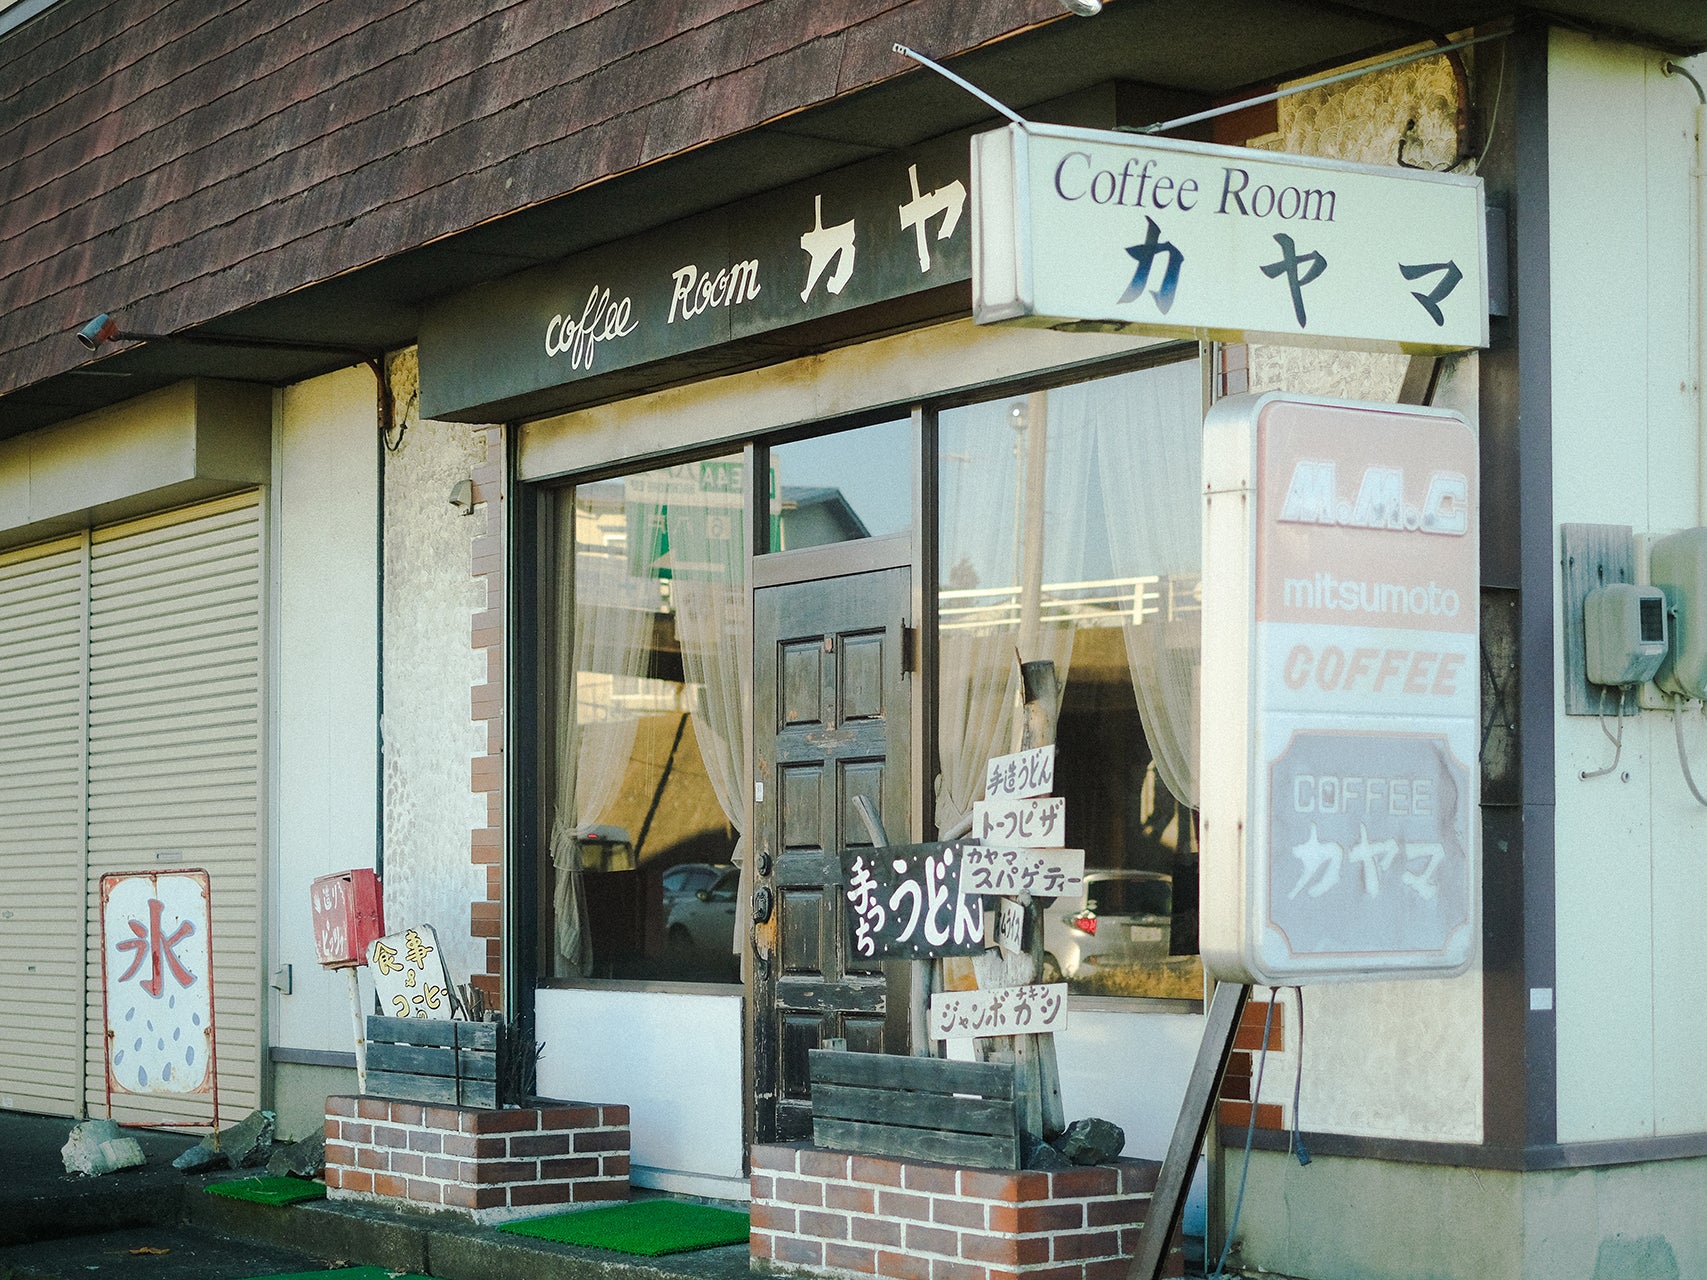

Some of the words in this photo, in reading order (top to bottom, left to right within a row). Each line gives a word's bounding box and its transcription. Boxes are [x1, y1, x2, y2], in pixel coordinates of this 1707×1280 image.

[1054, 151, 1199, 212] Coffee
[1214, 167, 1337, 222] Room
[1117, 215, 1463, 329] カヤマ
[545, 284, 639, 370] coffee
[667, 259, 761, 324] Room
[1283, 571, 1460, 618] mitsumoto
[1283, 643, 1465, 696] COFFEE
[987, 748, 1052, 796] 手造うどん
[1293, 774, 1434, 816] COFFEE
[983, 800, 1063, 840] トーフピザ
[967, 848, 1017, 866] カヤマ
[971, 860, 1081, 892] スパゲティー
[1288, 820, 1446, 900] カヤマ
[889, 848, 984, 947] うどん
[116, 898, 198, 999] 氷
[373, 929, 433, 976] 食事
[1015, 984, 1051, 1002] チキン
